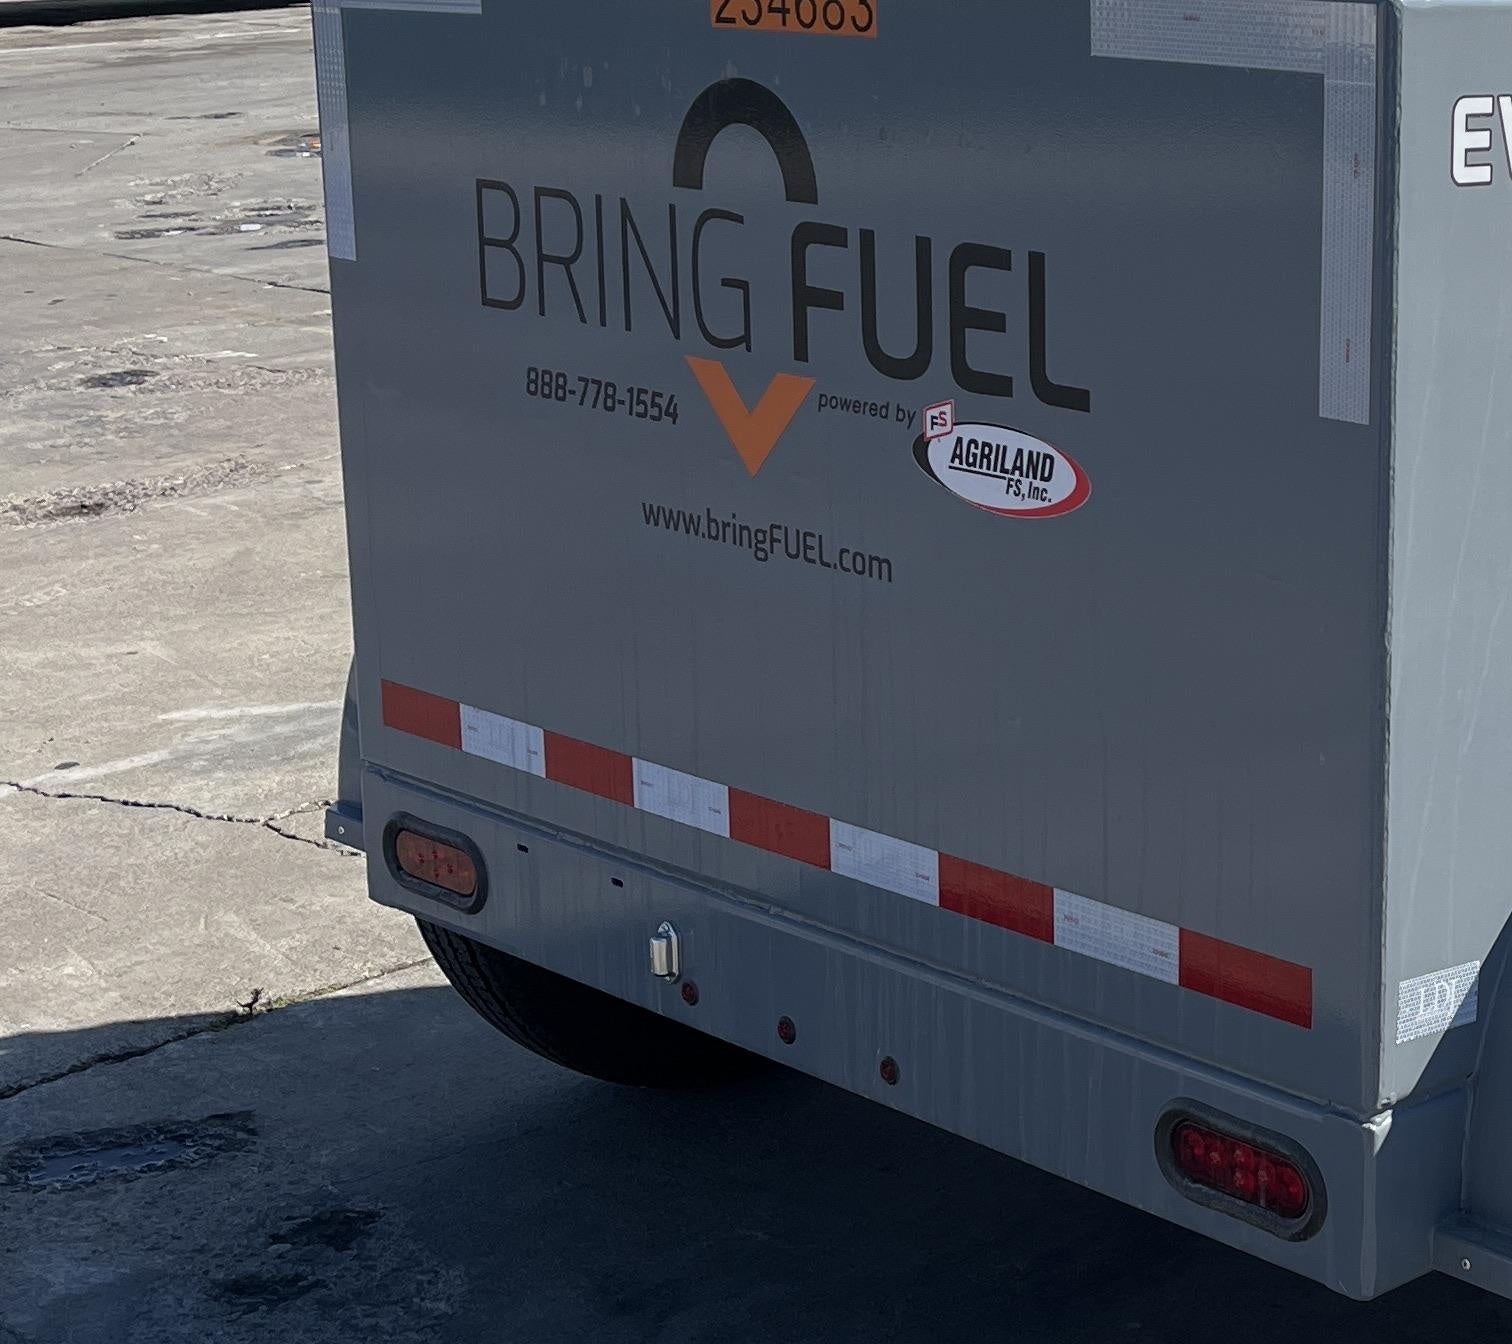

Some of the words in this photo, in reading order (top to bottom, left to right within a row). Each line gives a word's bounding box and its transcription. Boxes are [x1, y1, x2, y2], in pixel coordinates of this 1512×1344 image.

[476, 178, 752, 353] BRING
[790, 221, 1091, 413] FUEL
[526, 366, 679, 425] 888-778-1554
[818, 392, 889, 419] powered
[896, 404, 917, 430] by
[930, 411, 948, 431] FS
[950, 436, 1055, 483] AGRILAND
[1005, 476, 1026, 501] FS,
[1027, 479, 1052, 503] Inc.
[642, 501, 893, 582] www.bringFUEL.com
